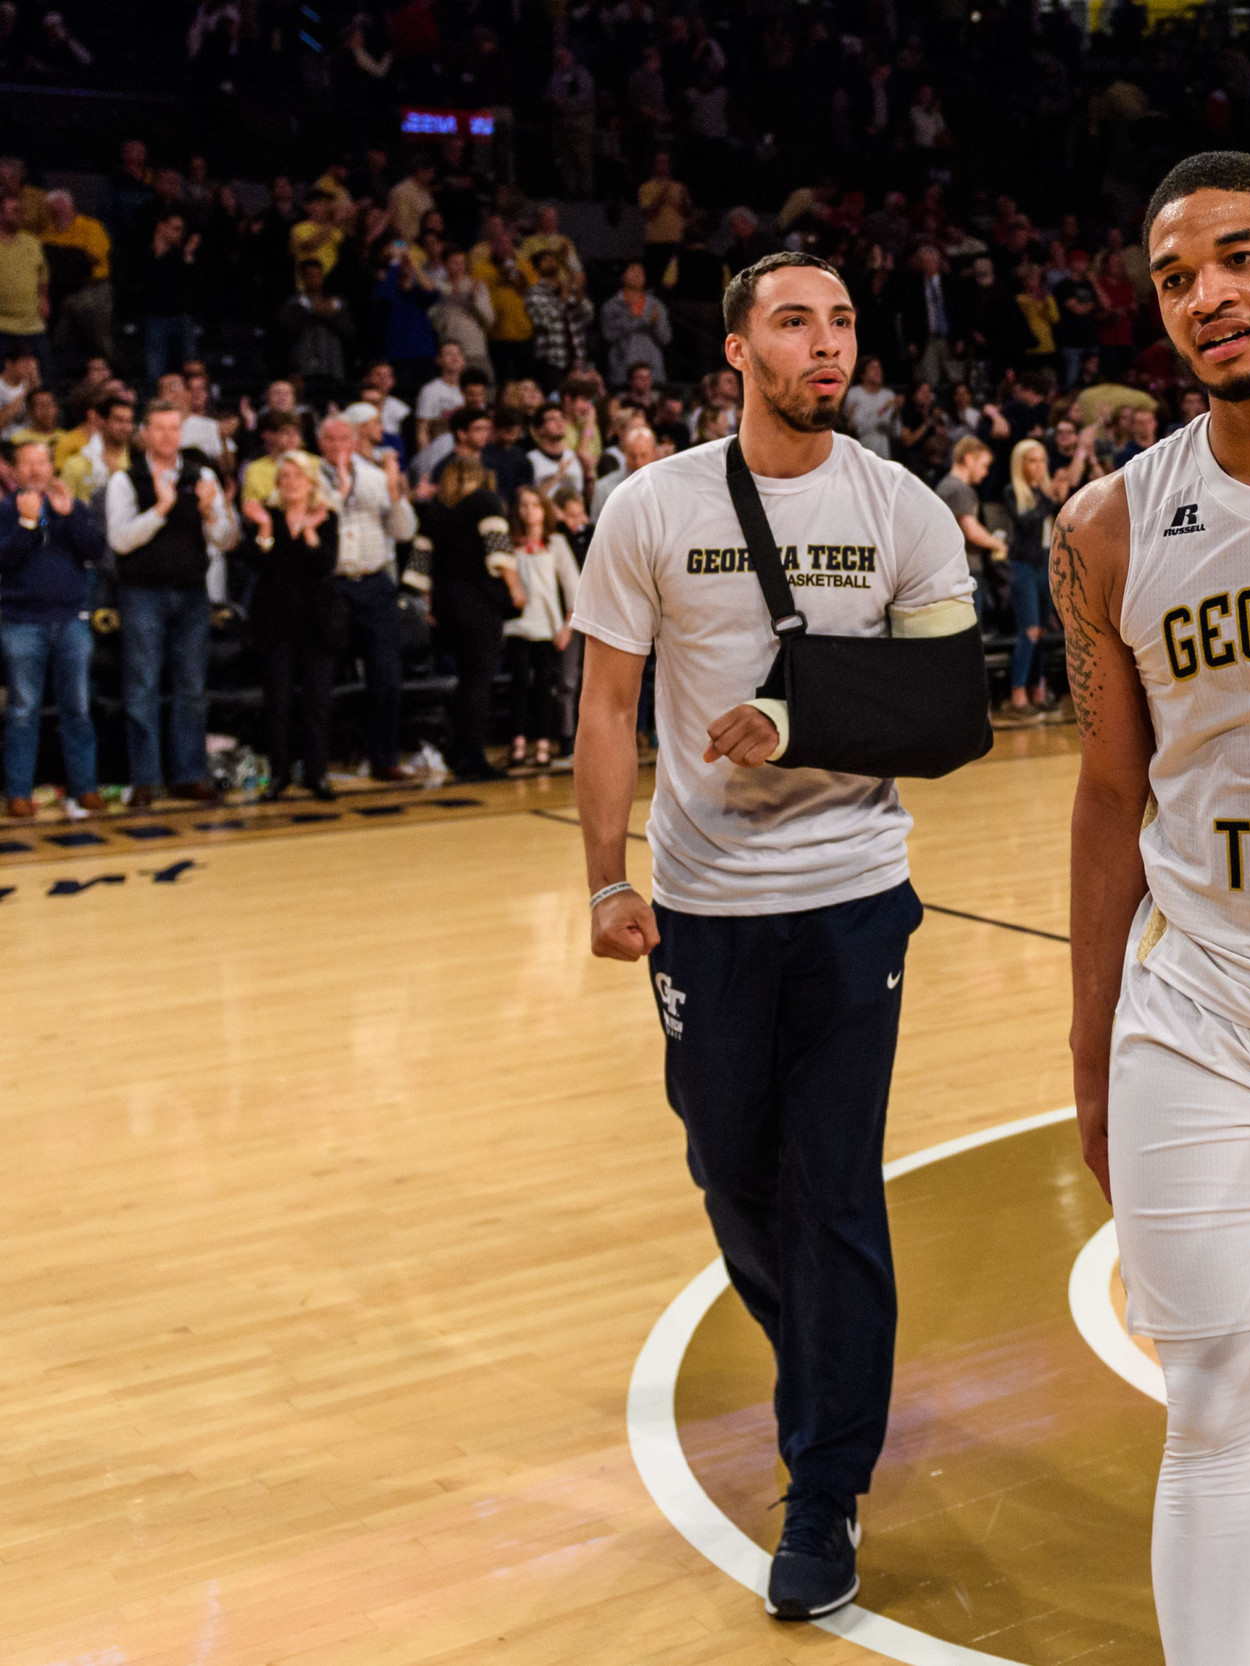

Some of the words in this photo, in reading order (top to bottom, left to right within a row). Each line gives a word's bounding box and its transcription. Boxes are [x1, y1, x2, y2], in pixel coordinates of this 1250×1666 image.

[1163, 524, 1206, 537] RUSSELL
[687, 547, 801, 574] GEORA
[807, 544, 876, 572] TECH
[788, 573, 872, 589] ASKETBALL
